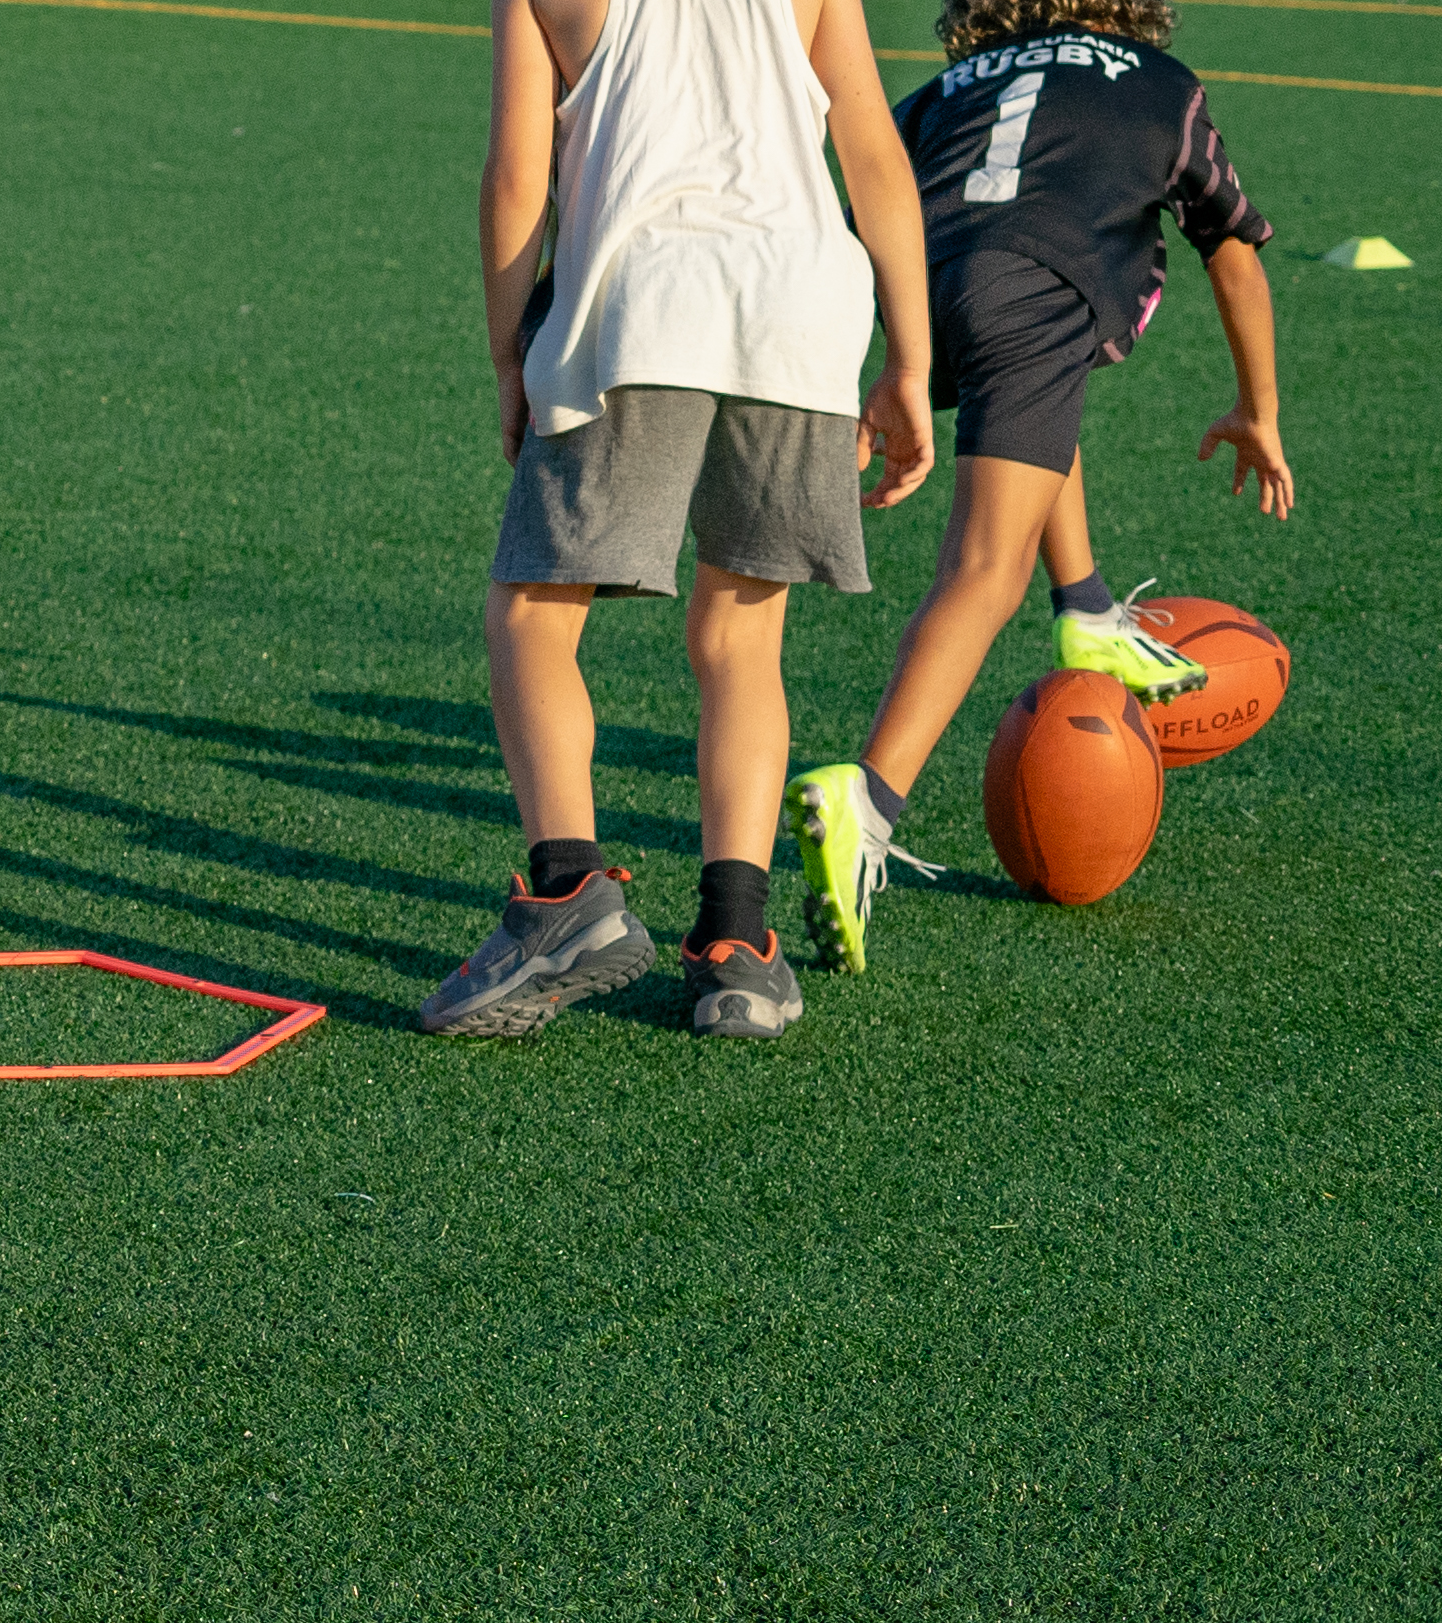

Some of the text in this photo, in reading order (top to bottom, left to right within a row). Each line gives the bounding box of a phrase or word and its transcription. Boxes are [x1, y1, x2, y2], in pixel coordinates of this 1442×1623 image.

[942, 43, 1131, 98] RUGBY
[1027, 33, 1141, 69] EULARIA
[963, 71, 1045, 202] 1
